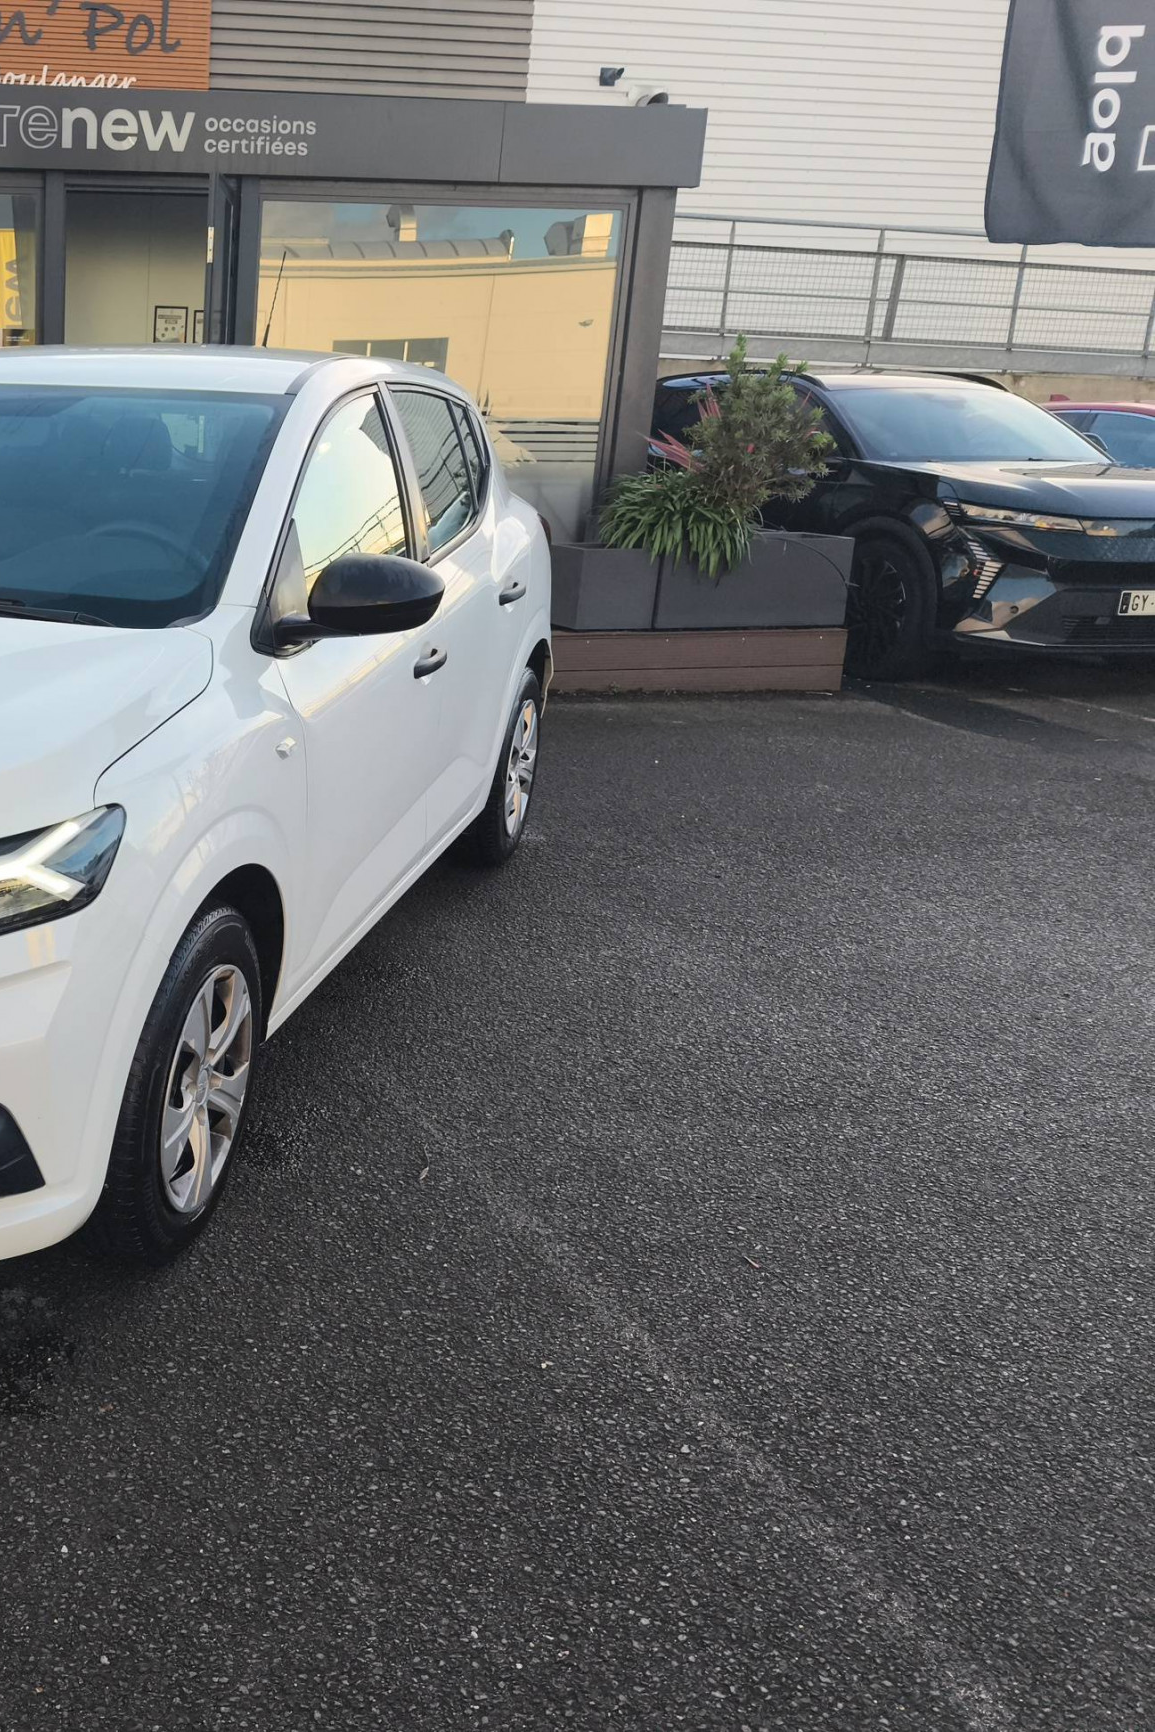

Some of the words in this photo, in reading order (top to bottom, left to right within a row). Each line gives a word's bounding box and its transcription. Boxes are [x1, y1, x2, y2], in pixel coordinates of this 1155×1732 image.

[79, 0, 182, 55] Pol
[204, 115, 317, 136] occasions
[203, 134, 309, 156] certifiées
